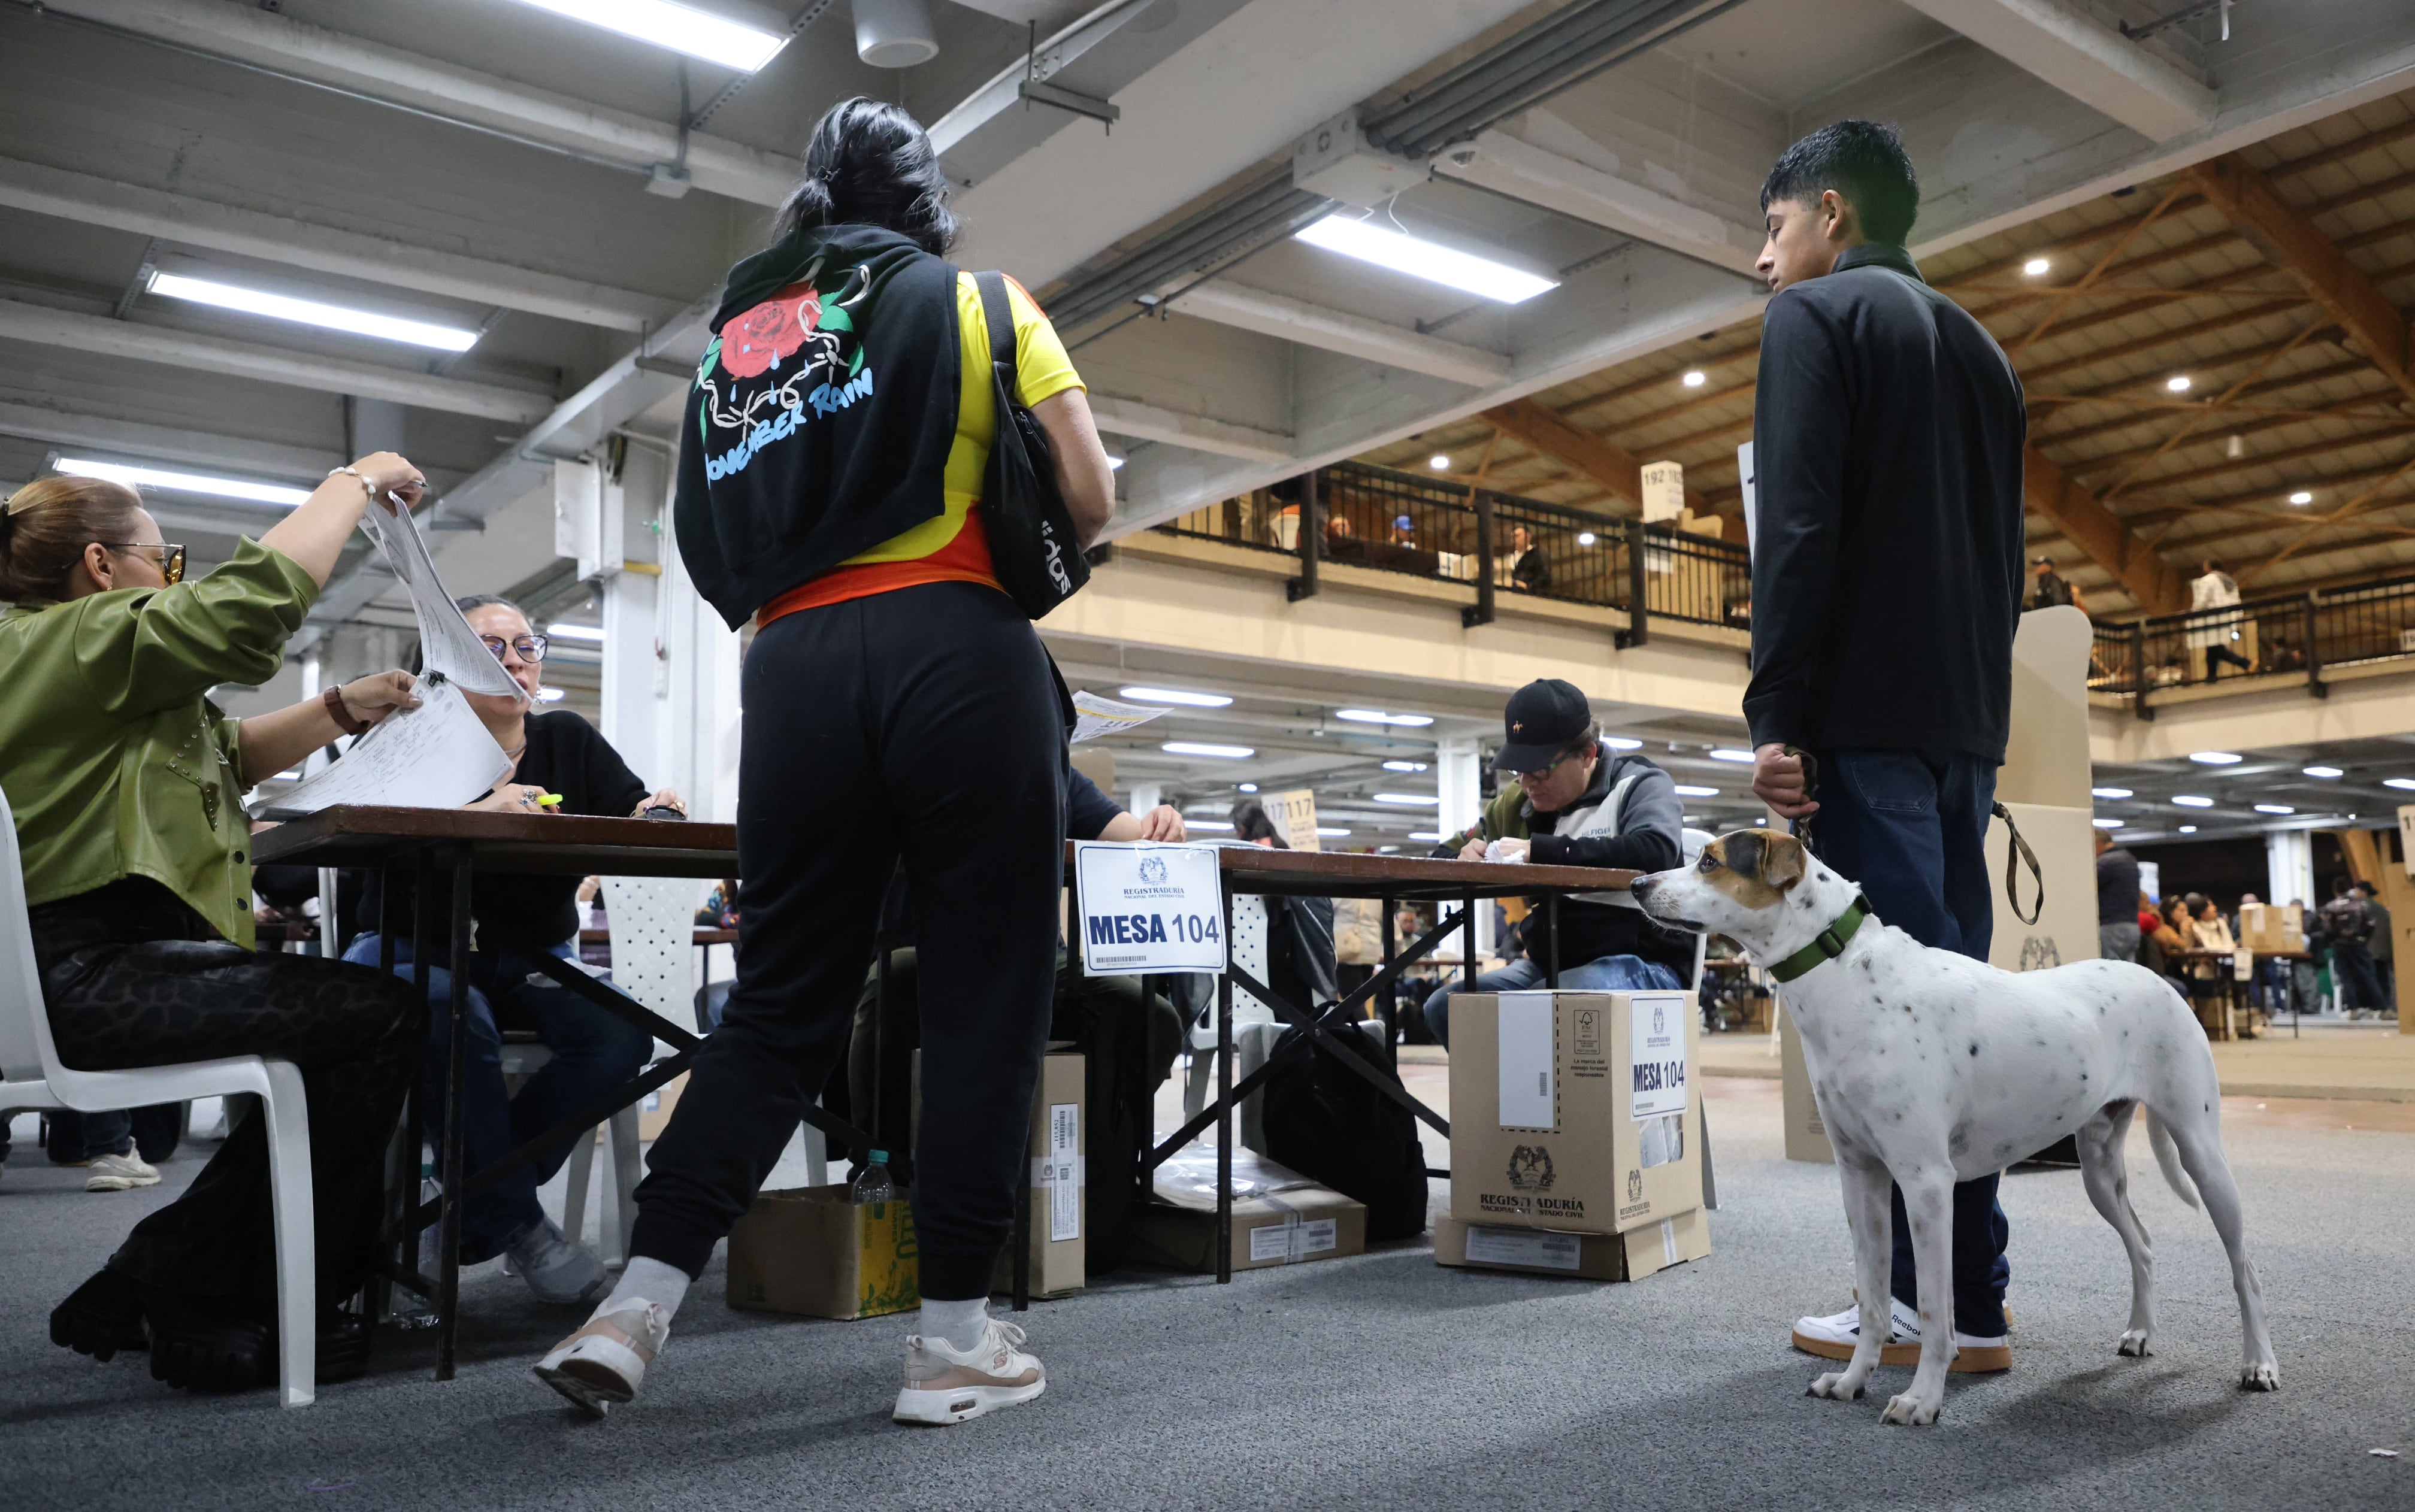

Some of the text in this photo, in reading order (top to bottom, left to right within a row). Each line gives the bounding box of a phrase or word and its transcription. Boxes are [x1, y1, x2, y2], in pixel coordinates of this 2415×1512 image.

[808, 366, 873, 420] RAIN
[1041, 520, 1072, 595] idas
[1285, 798, 1311, 819] 117
[1124, 886, 1184, 895] REGISTRADURÍA
[1088, 914, 1219, 945] MESA 104
[1633, 1060, 1684, 1093] MESA 104
[1480, 1205, 1515, 1213] NACIONAL
